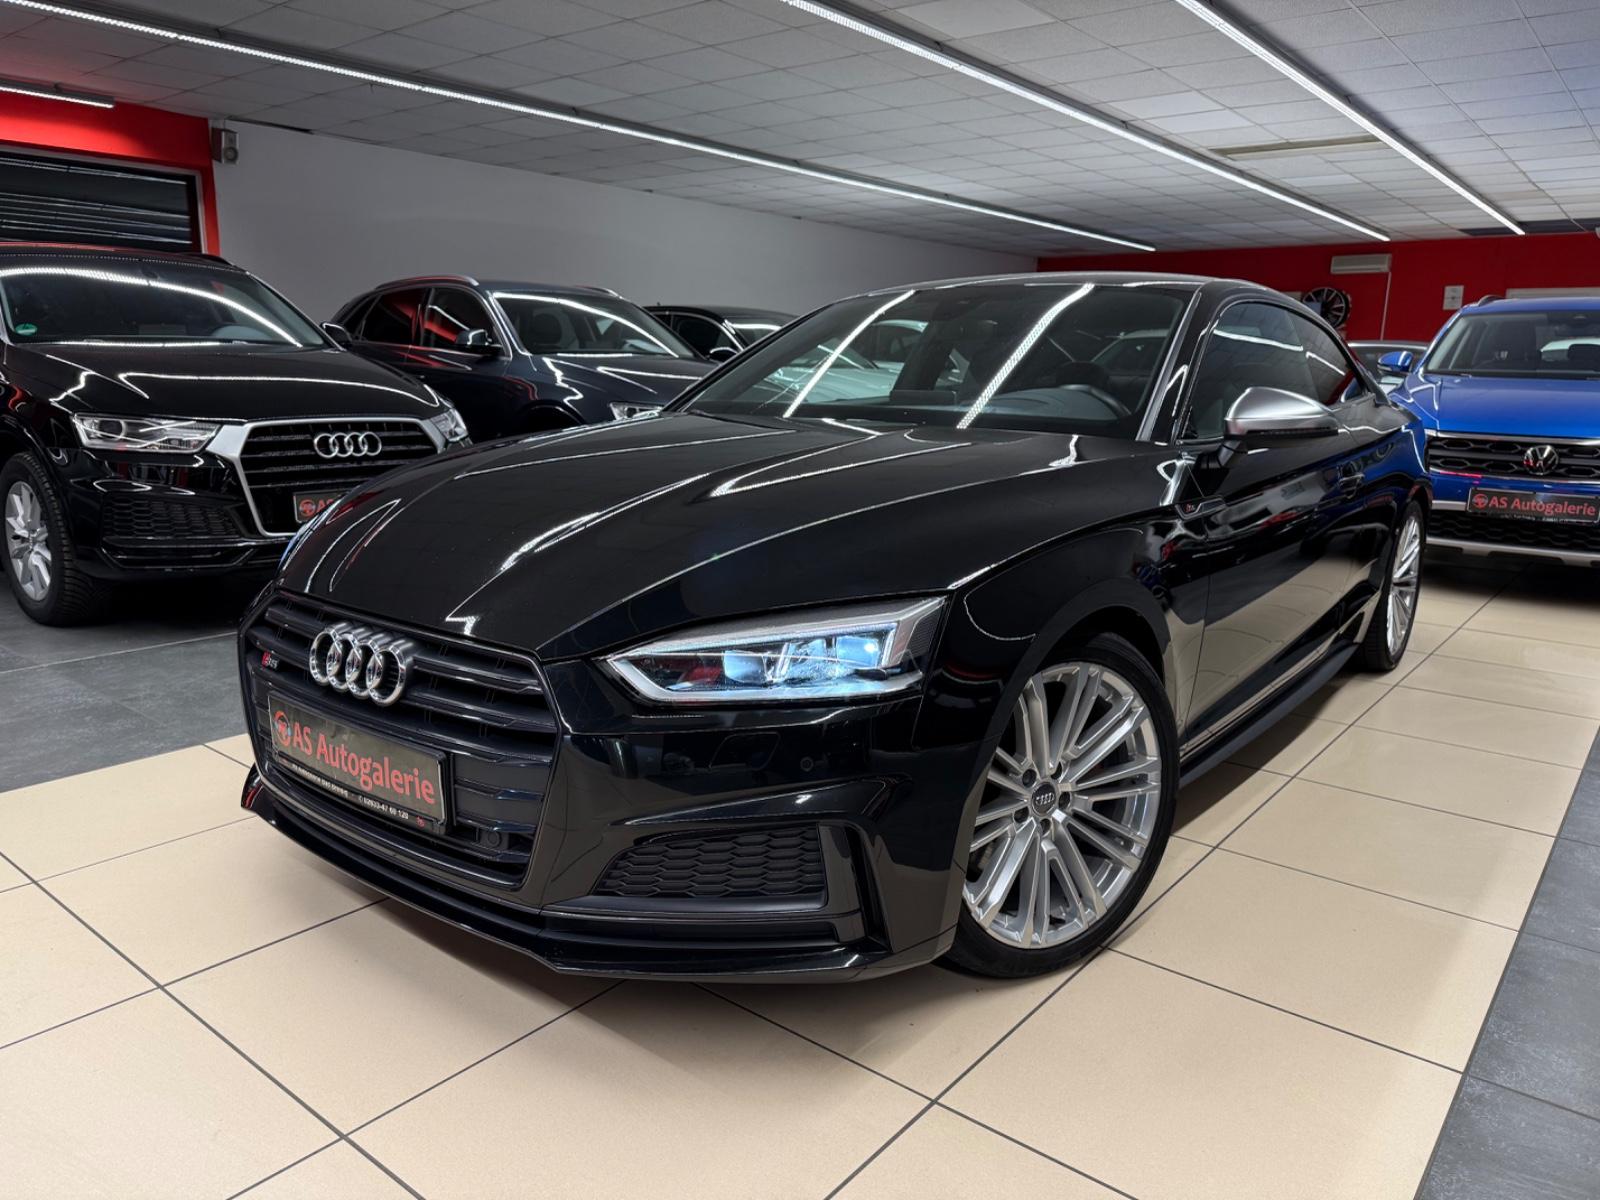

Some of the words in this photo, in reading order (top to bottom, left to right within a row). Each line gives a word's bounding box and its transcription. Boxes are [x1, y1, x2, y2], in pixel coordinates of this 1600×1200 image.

[1489, 496, 1508, 509] AS
[1511, 498, 1596, 516] Autogalerie
[292, 721, 313, 756] AS
[316, 732, 436, 804] Autogalerie
